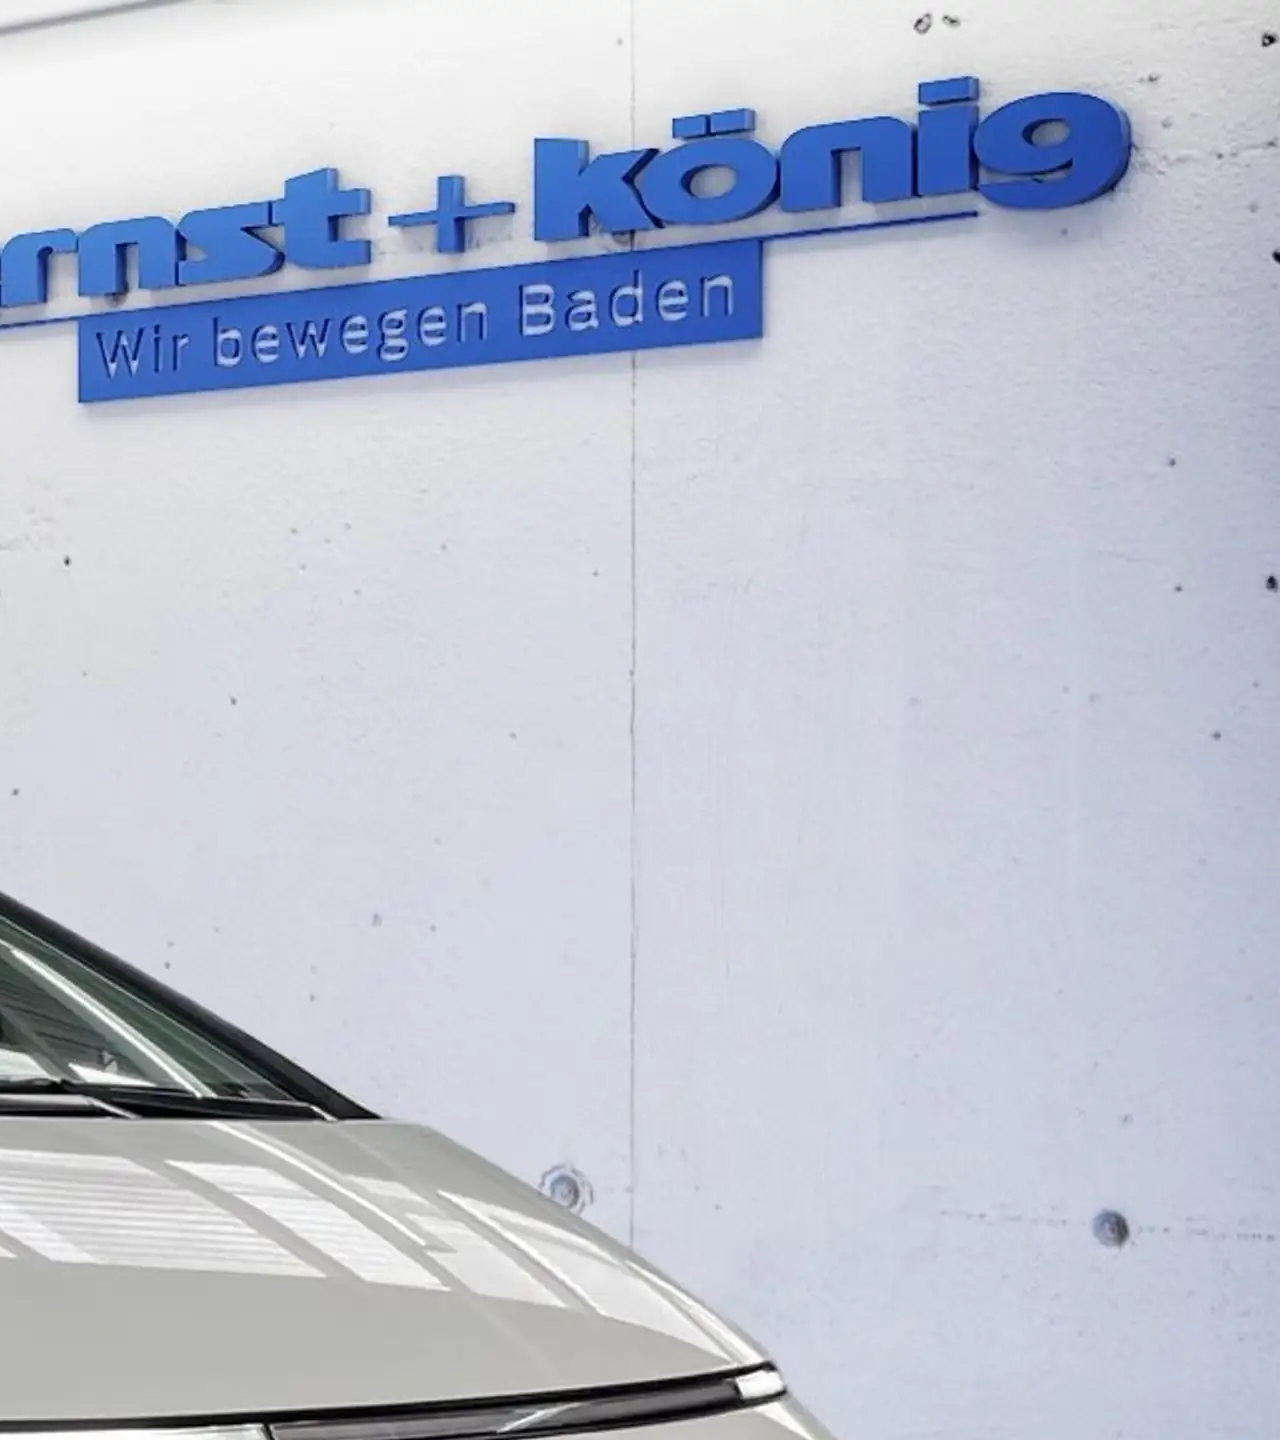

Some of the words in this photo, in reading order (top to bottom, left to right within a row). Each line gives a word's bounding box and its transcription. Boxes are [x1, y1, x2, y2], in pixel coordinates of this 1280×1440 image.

[96, 324, 190, 381] Wir
[211, 298, 489, 363] bewegen
[518, 268, 736, 338] Baden
